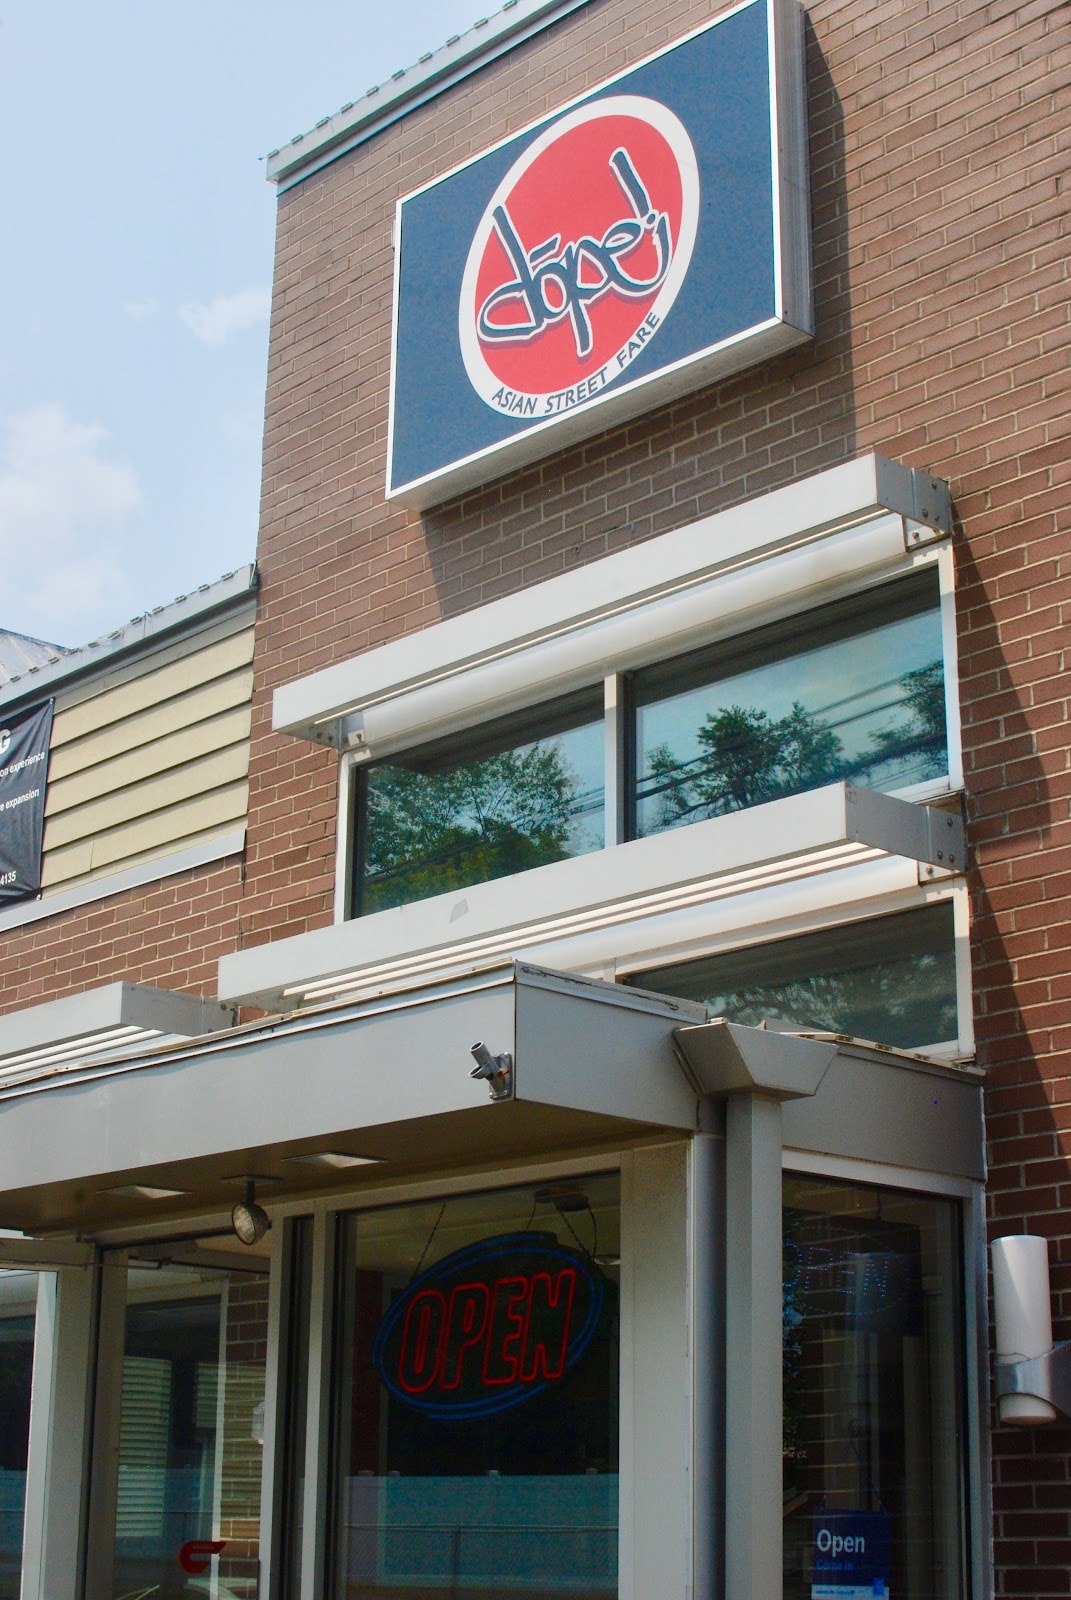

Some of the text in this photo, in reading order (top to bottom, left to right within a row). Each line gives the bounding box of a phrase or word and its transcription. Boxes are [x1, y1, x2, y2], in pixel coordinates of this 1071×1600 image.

[492, 312, 660, 415] ASIAN STREET FARE
[10, 751, 45, 773] experience
[5, 789, 40, 809] expansion
[399, 1268, 577, 1393] OPEN
[816, 1528, 865, 1558] Open
